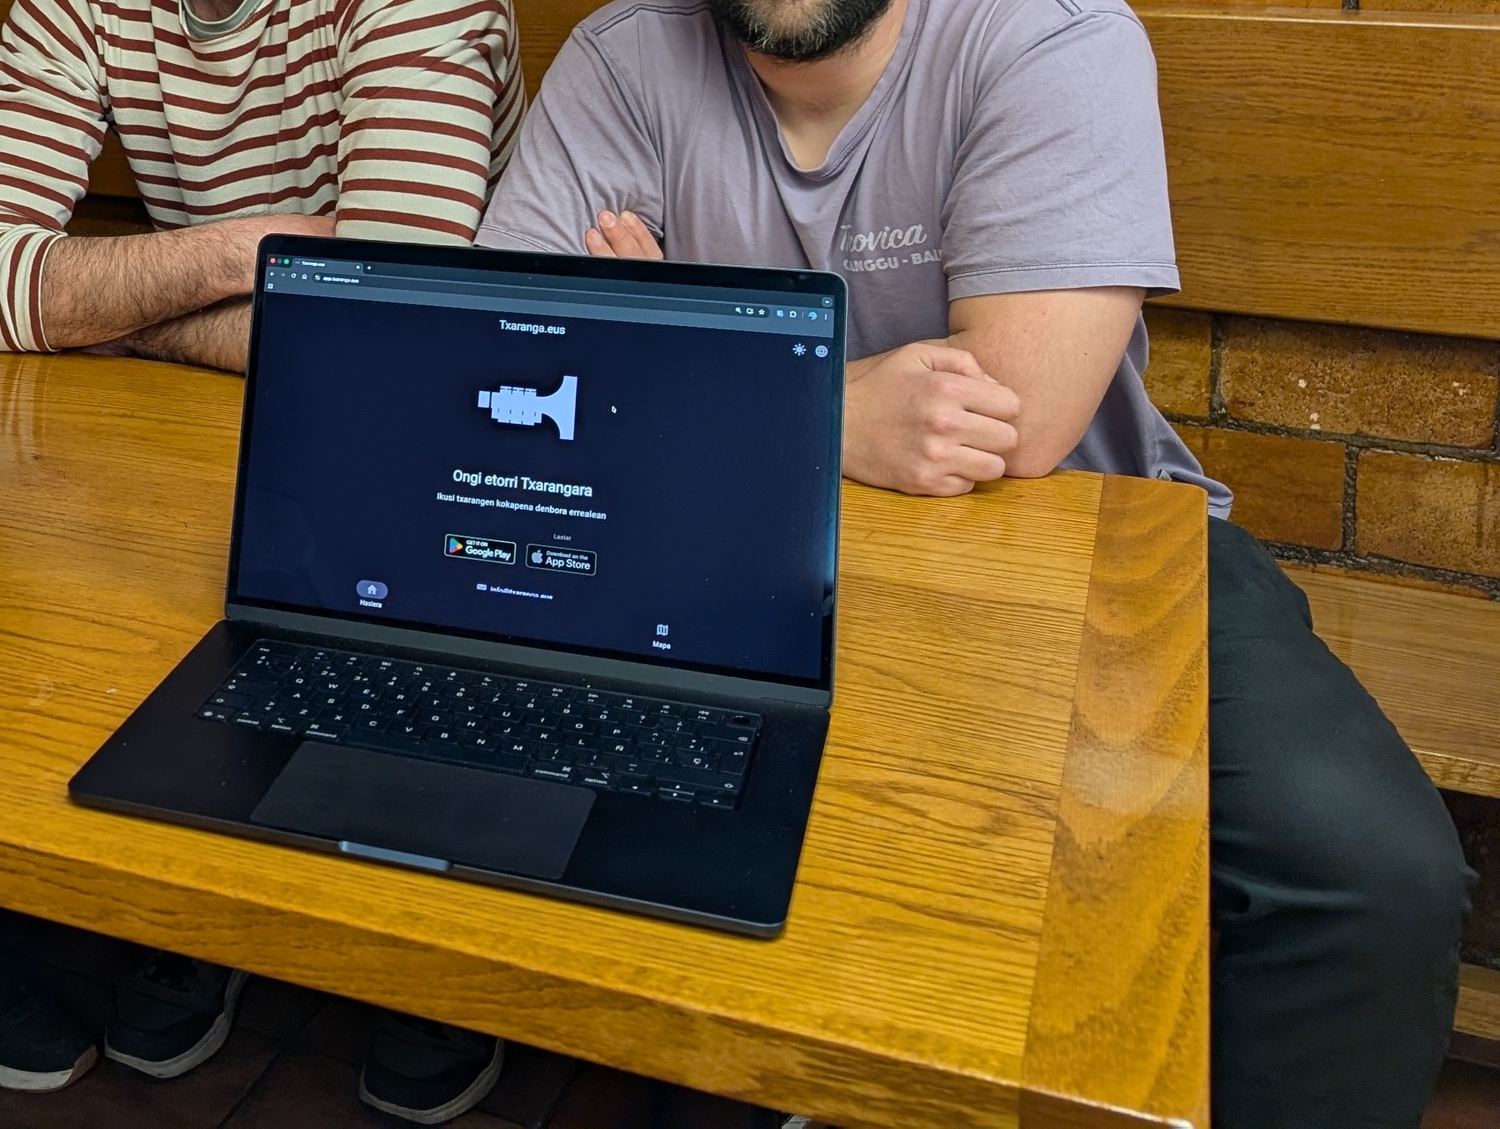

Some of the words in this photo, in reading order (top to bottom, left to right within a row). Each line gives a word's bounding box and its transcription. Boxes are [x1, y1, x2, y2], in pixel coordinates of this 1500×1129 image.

[499, 319, 566, 335] Txaranga.eus
[453, 469, 482, 487] Ongi
[484, 474, 518, 489] etorri
[520, 476, 593, 498] Txarangara
[436, 492, 455, 502] Ikusi
[456, 494, 495, 507] txarangen
[496, 499, 534, 512] kokapena
[535, 504, 568, 515] denbora
[569, 508, 607, 520] errealean
[553, 533, 572, 541] Laster
[465, 545, 494, 558] Google
[494, 549, 511, 561] Play
[545, 556, 565, 568] App
[566, 559, 591, 570] Store
[360, 599, 382, 608] Hasiera
